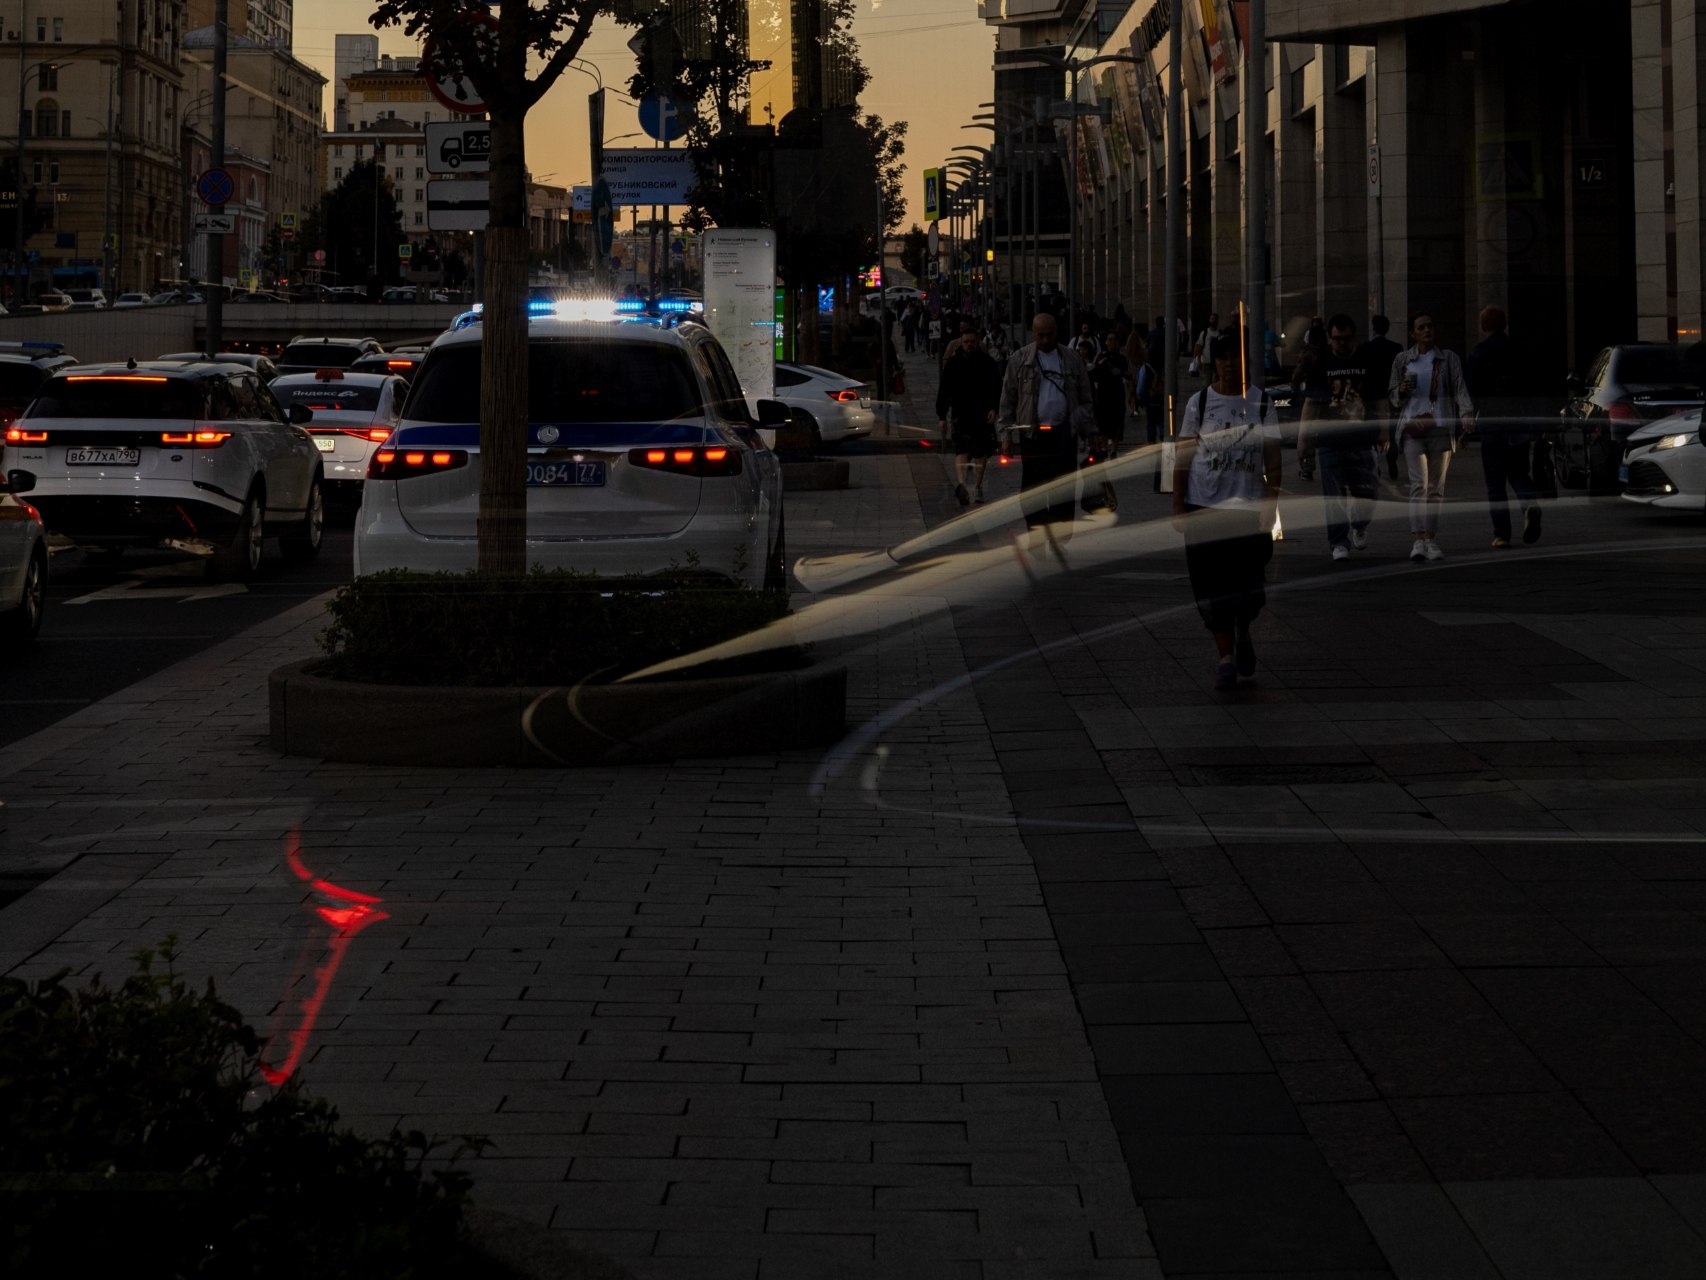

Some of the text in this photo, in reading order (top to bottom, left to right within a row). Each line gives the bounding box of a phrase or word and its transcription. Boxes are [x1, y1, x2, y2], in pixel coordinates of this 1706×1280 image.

[468, 135, 491, 151] 2,5
[602, 155, 685, 163] КОМПОЗИТОРСКАЯ
[601, 166, 627, 174] улица
[1578, 165, 1603, 183] 1/2
[607, 180, 678, 189] РУБНИКОВСКИЙ
[1327, 368, 1367, 377] TURNSTILE
[578, 464, 597, 477] 77
